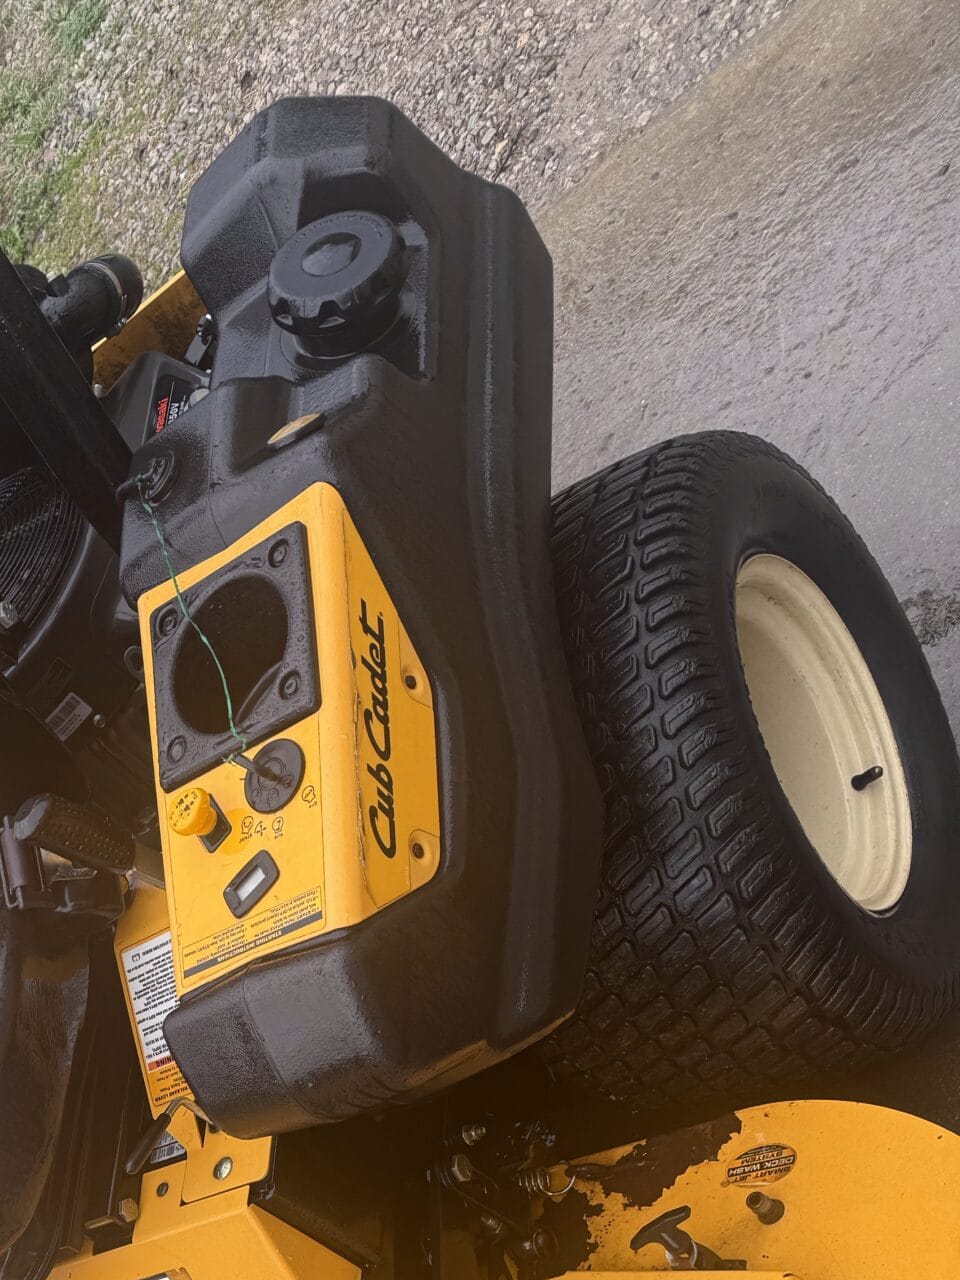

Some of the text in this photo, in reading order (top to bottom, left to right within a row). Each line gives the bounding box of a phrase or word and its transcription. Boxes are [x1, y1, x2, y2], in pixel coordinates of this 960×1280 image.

[359, 598, 397, 859] Cub Cadet
[729, 1156, 794, 1177] DECK WASH
